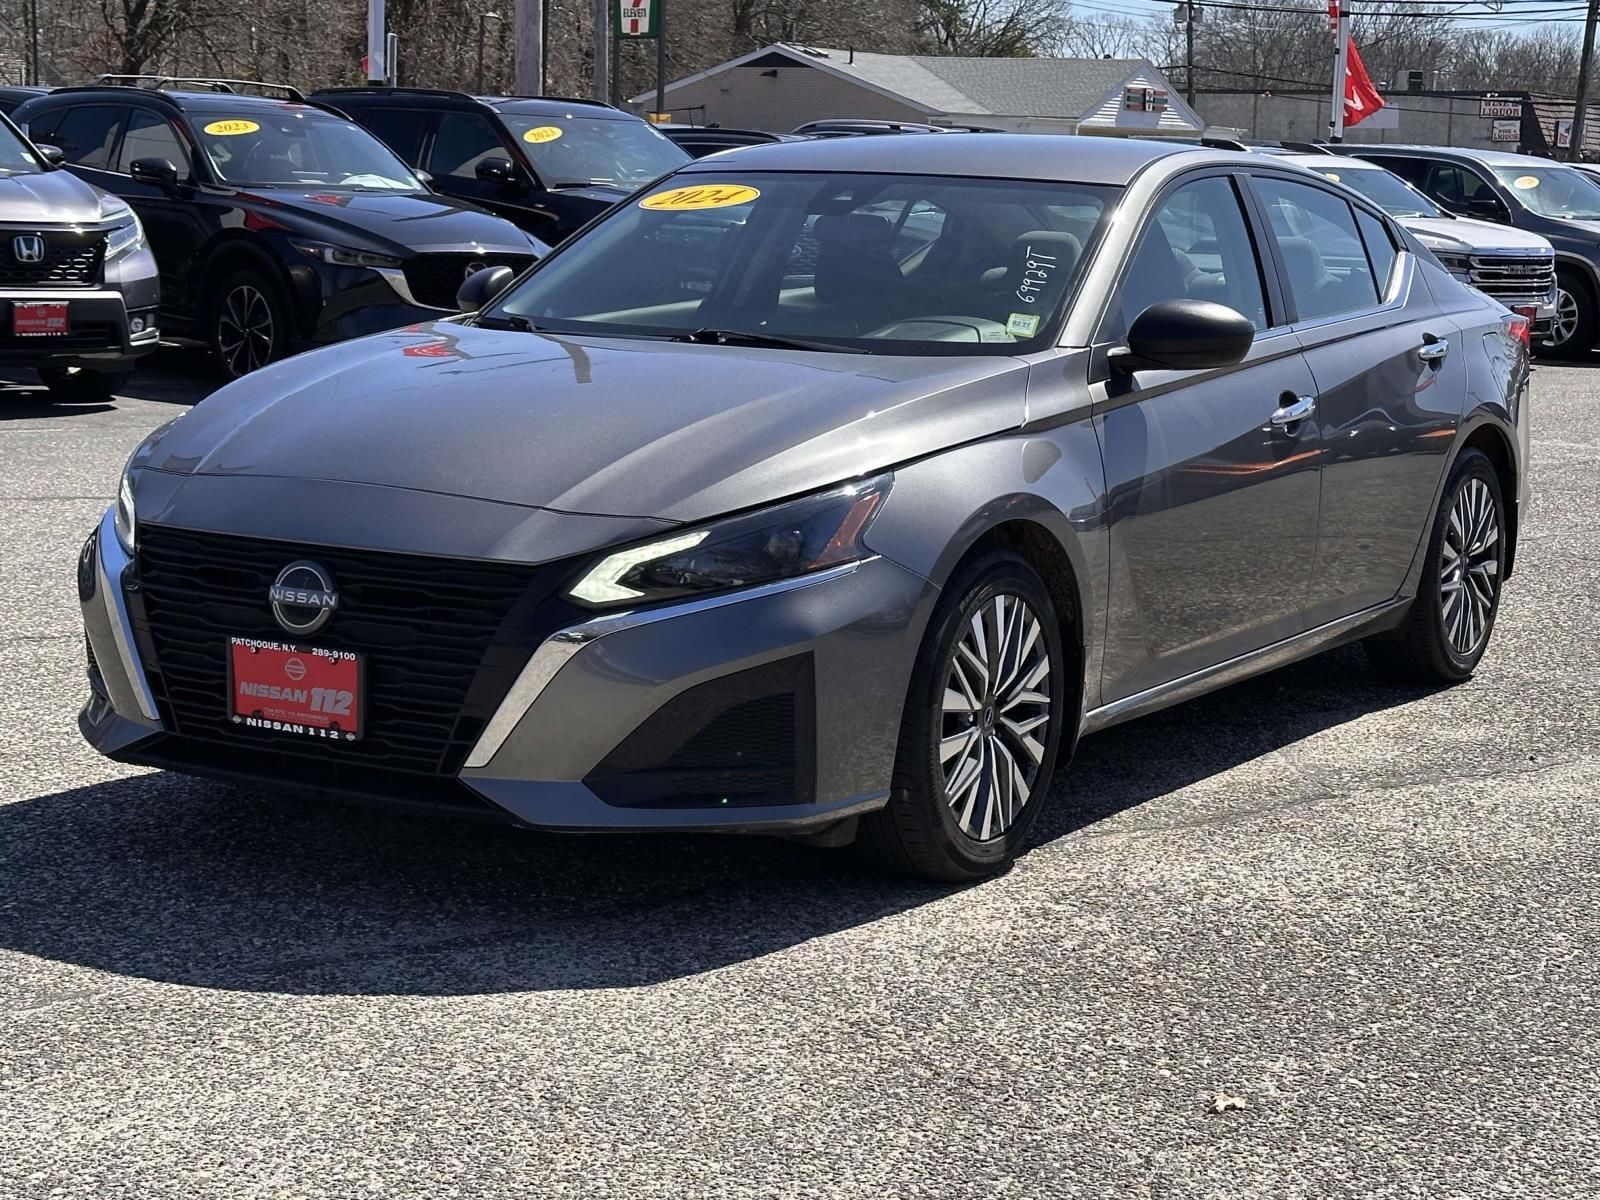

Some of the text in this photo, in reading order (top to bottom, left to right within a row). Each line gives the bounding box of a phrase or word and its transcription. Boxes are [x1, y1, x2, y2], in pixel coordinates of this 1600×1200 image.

[1482, 108, 1519, 116] LIQUOR
[216, 122, 249, 133] 2023
[650, 189, 747, 206] 2024
[1016, 246, 1056, 303] 69929T
[269, 587, 336, 606] NISSAN
[231, 637, 356, 661] PATCHOGUE, N.Y. 289-9100
[240, 681, 353, 715] NISSAN 112
[246, 717, 303, 734] NISSAN
